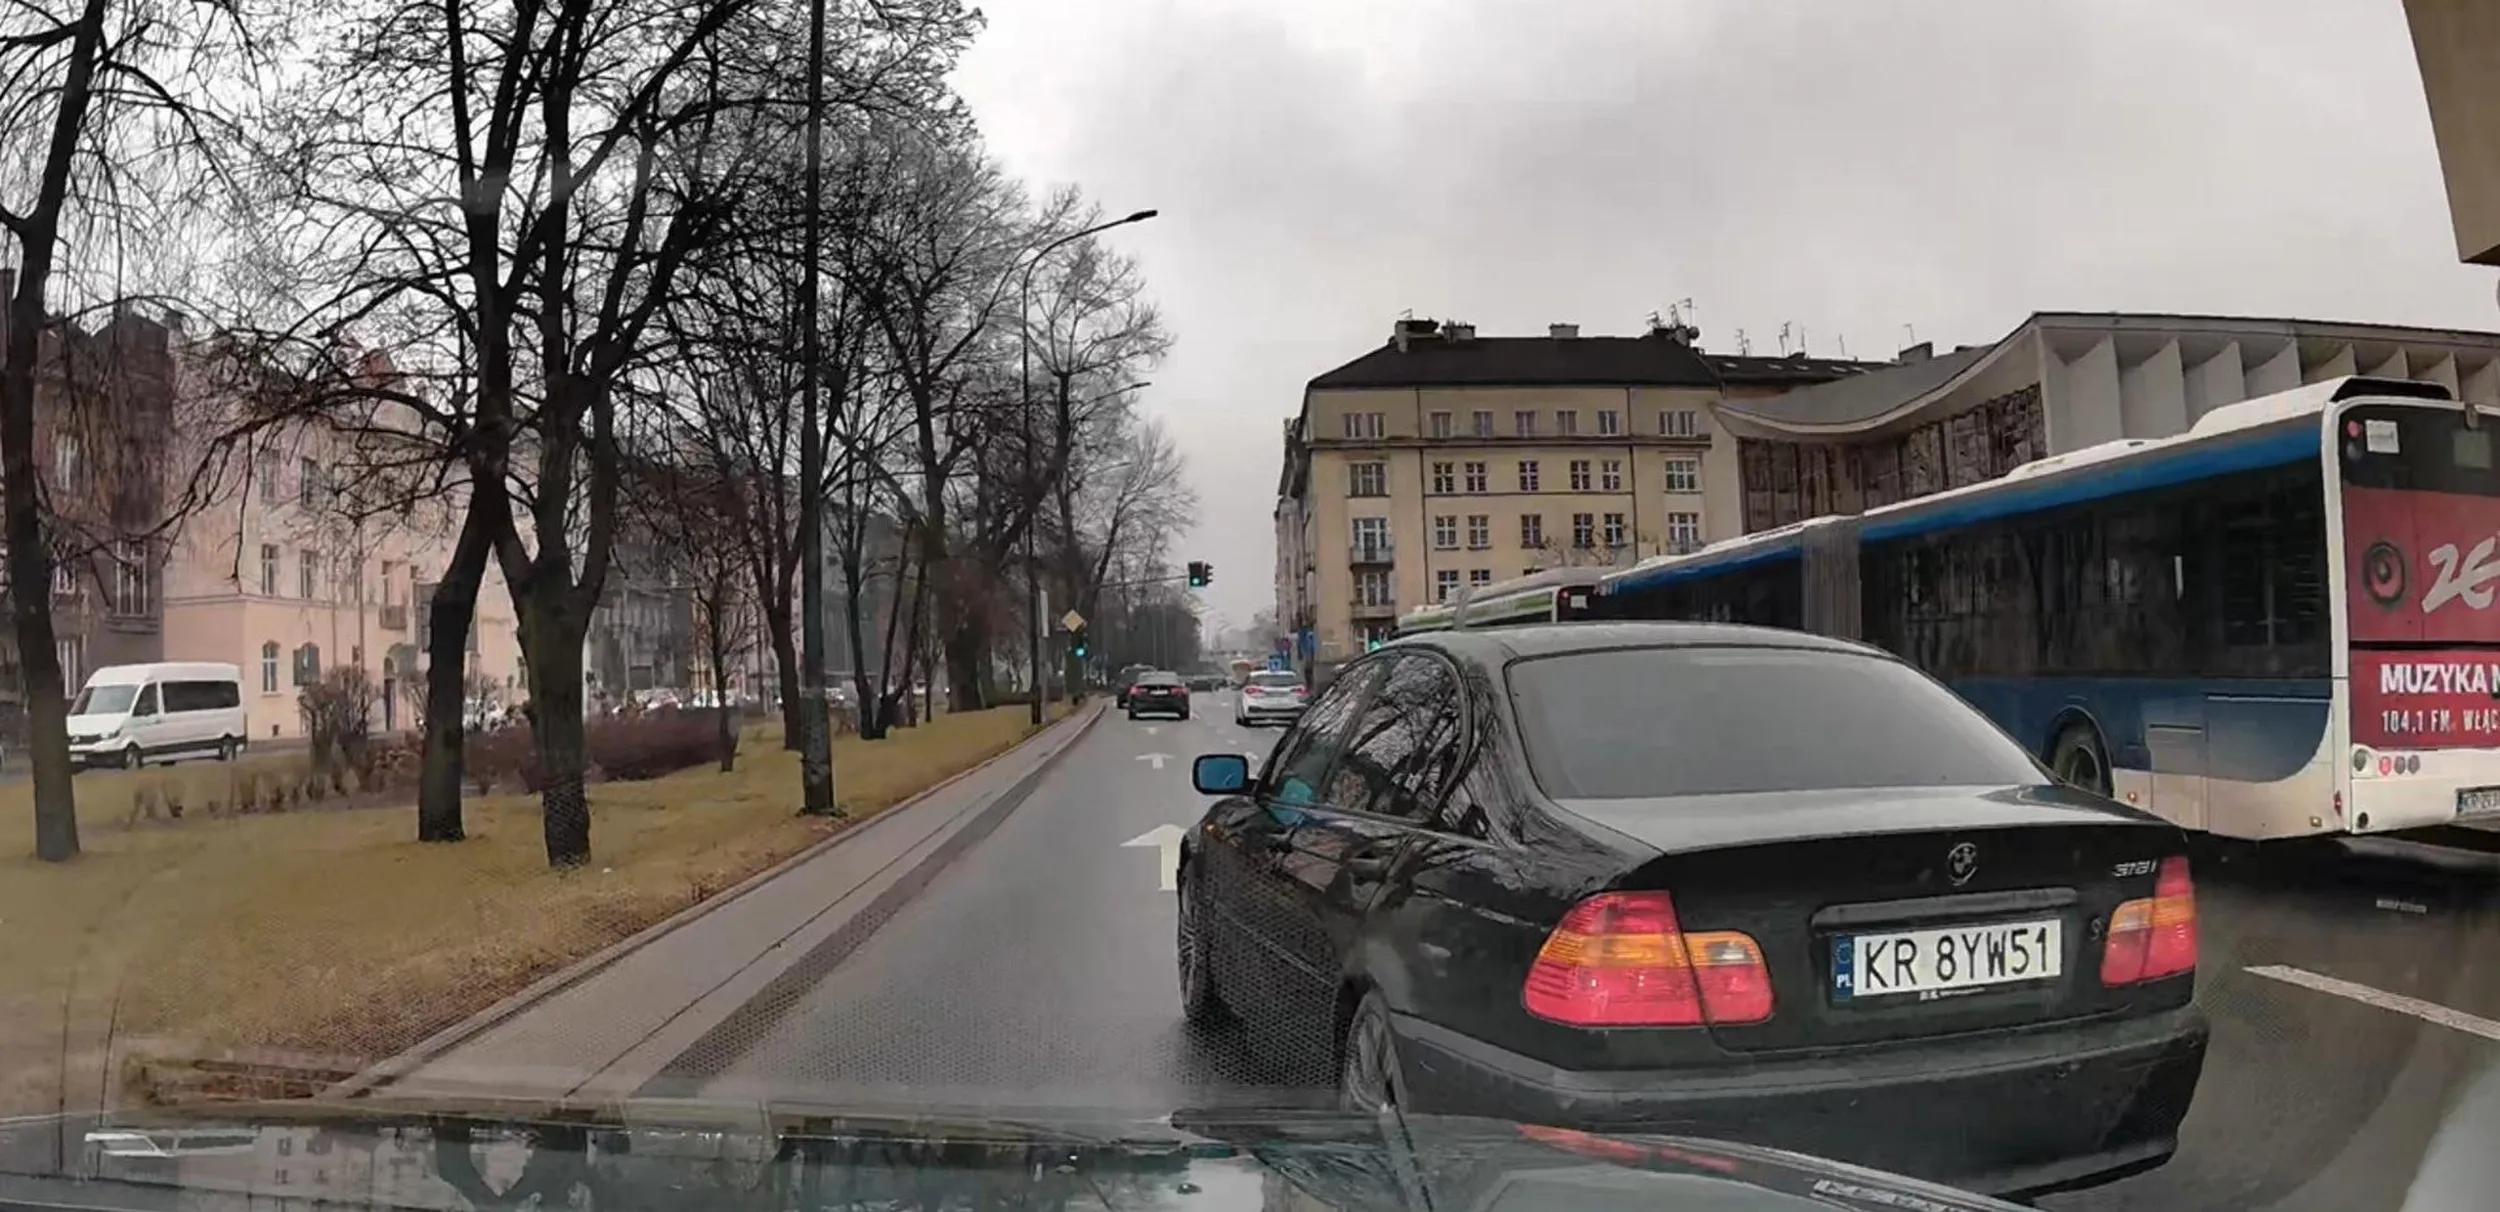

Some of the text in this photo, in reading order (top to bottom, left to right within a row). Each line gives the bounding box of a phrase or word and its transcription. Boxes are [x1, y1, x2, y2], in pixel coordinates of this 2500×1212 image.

[2381, 663, 2488, 694] MUZYKA
[1866, 927, 2047, 989] KR 8YW51
[1836, 974, 1853, 989] PL
